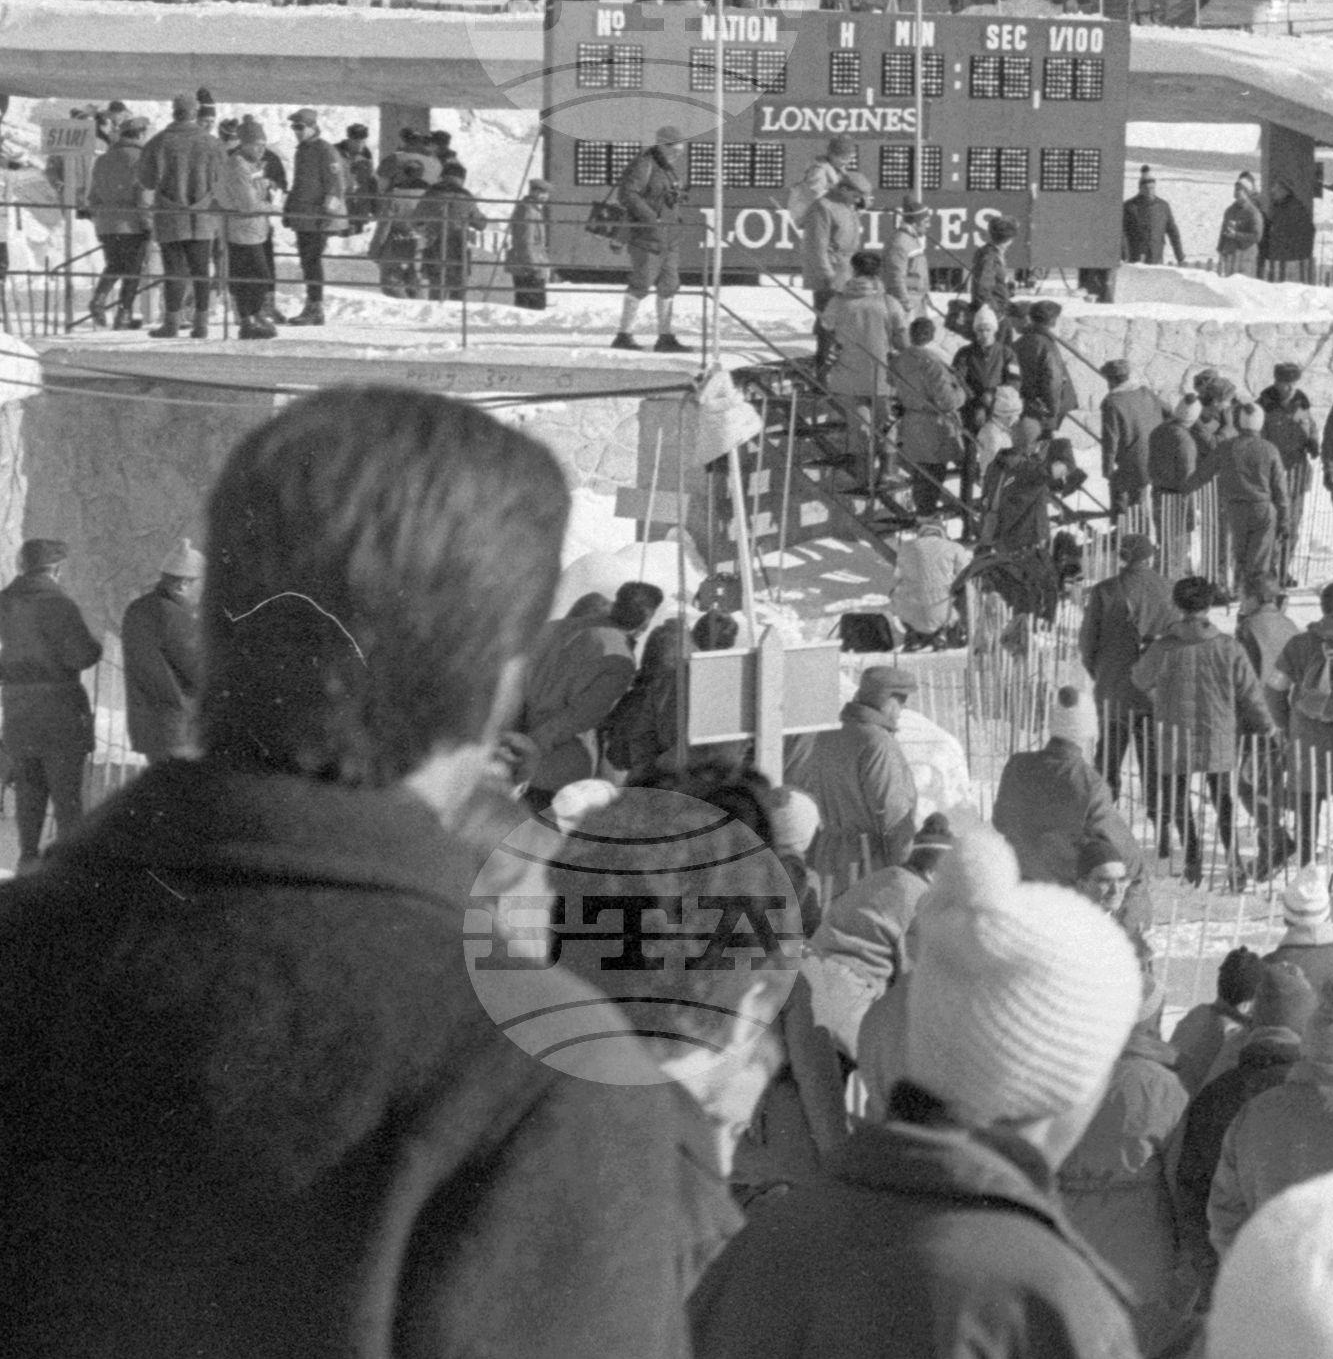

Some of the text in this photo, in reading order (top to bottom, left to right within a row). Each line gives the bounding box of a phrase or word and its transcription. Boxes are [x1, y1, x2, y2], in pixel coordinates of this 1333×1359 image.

[701, 14, 777, 42] NATION
[840, 22, 855, 48] H
[895, 21, 935, 47] MIN
[986, 24, 1028, 51] SEC
[1049, 26, 1104, 53] 1/100
[761, 106, 918, 132] LONGINES
[700, 207, 1003, 249] LONIES
